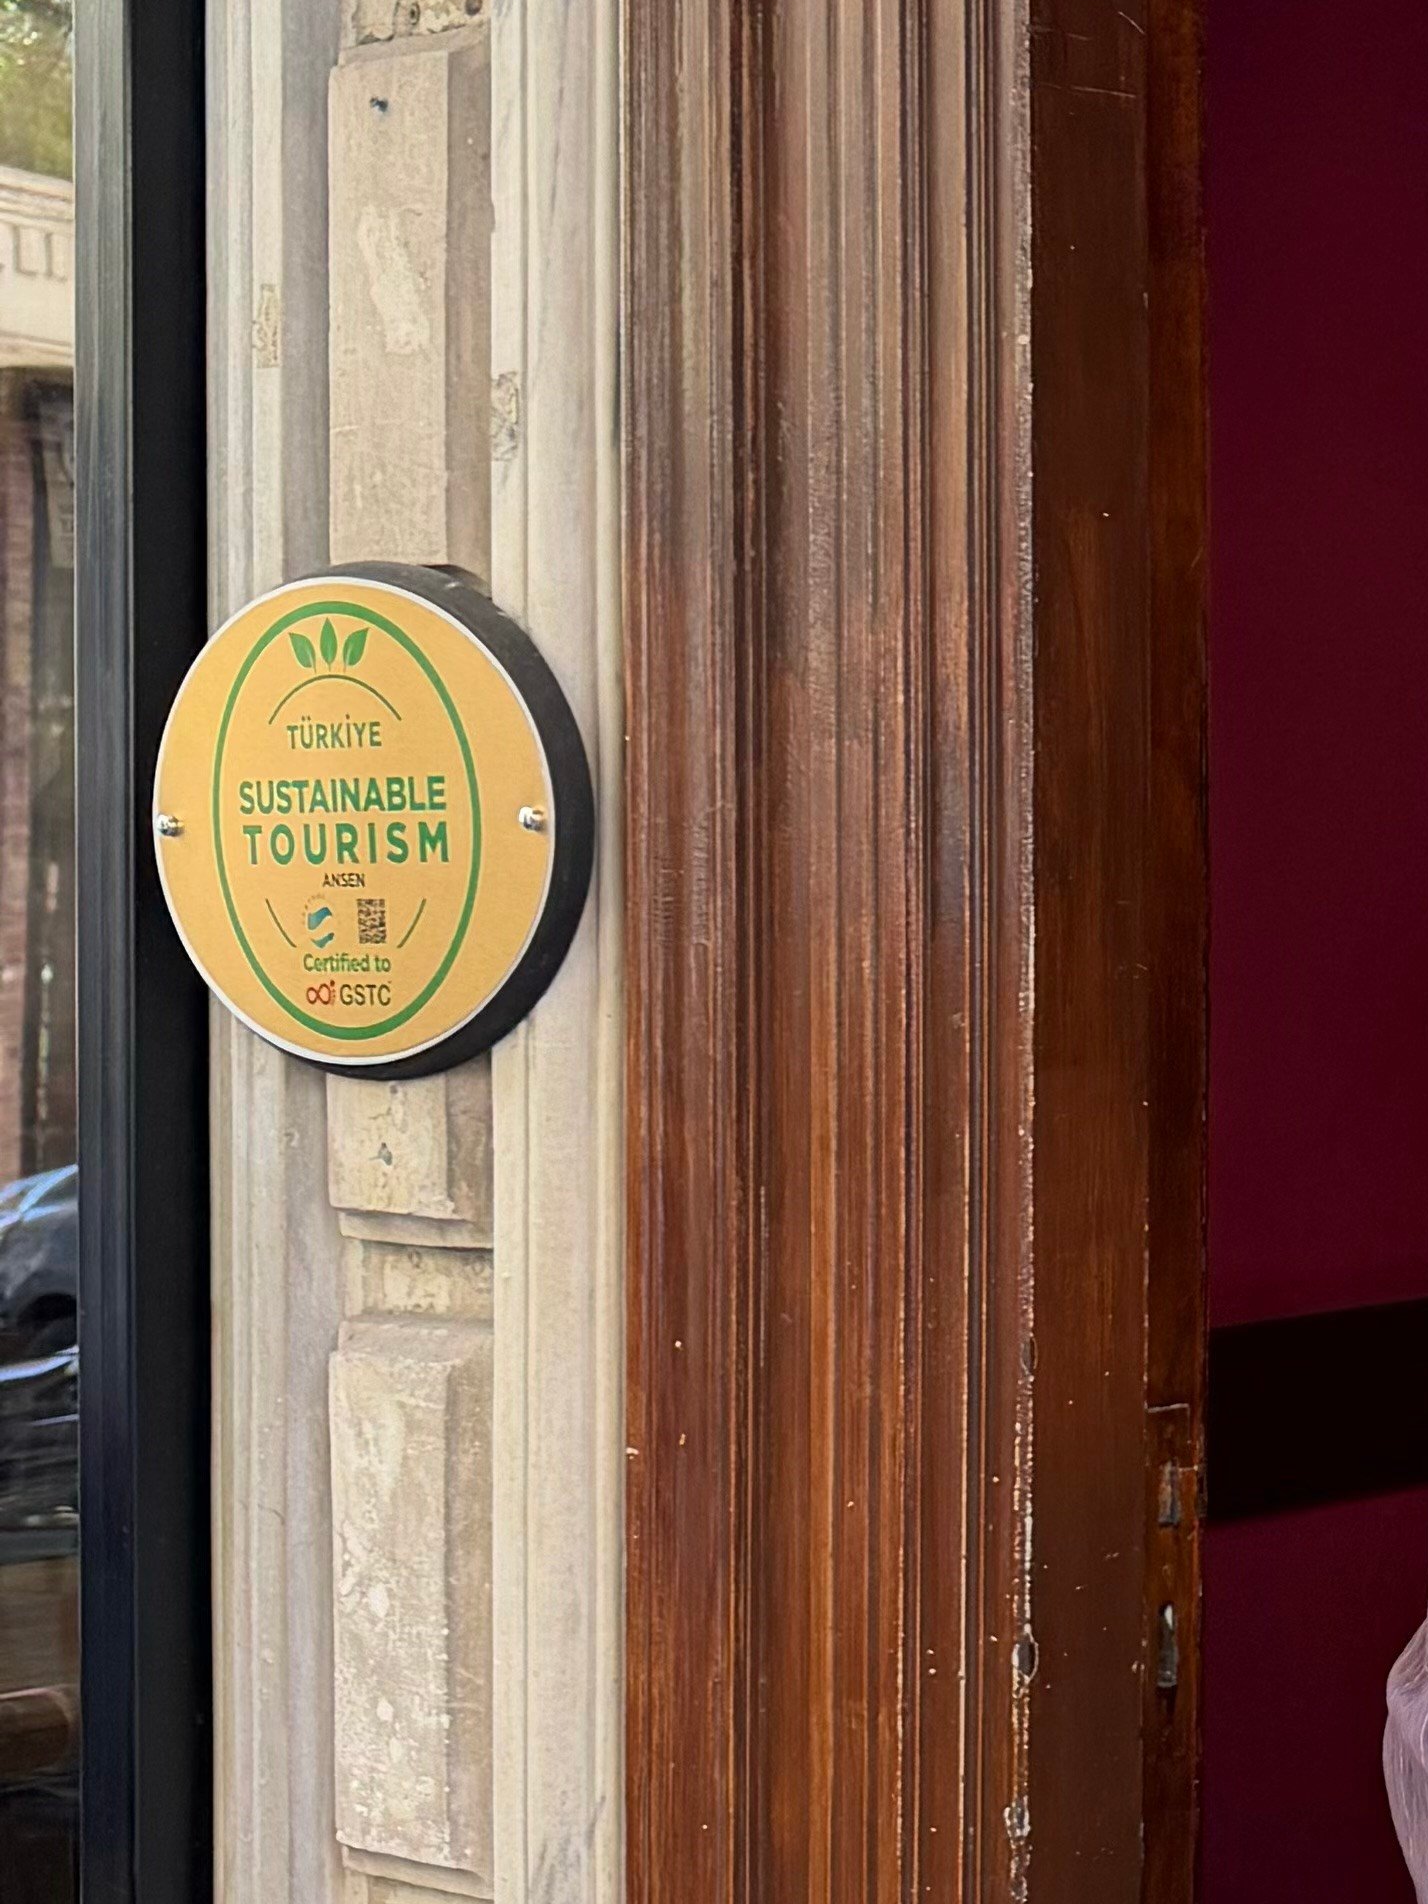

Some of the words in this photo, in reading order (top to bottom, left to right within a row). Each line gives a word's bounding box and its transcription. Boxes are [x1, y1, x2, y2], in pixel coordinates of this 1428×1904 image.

[286, 713, 383, 750] TÜRKİYE
[238, 775, 448, 816] SUSTAINABLE
[242, 820, 450, 866] TOURISM
[321, 872, 366, 888] ANSEN
[303, 952, 371, 973] Certified
[374, 954, 392, 973] to
[339, 983, 392, 1007] GSTC
